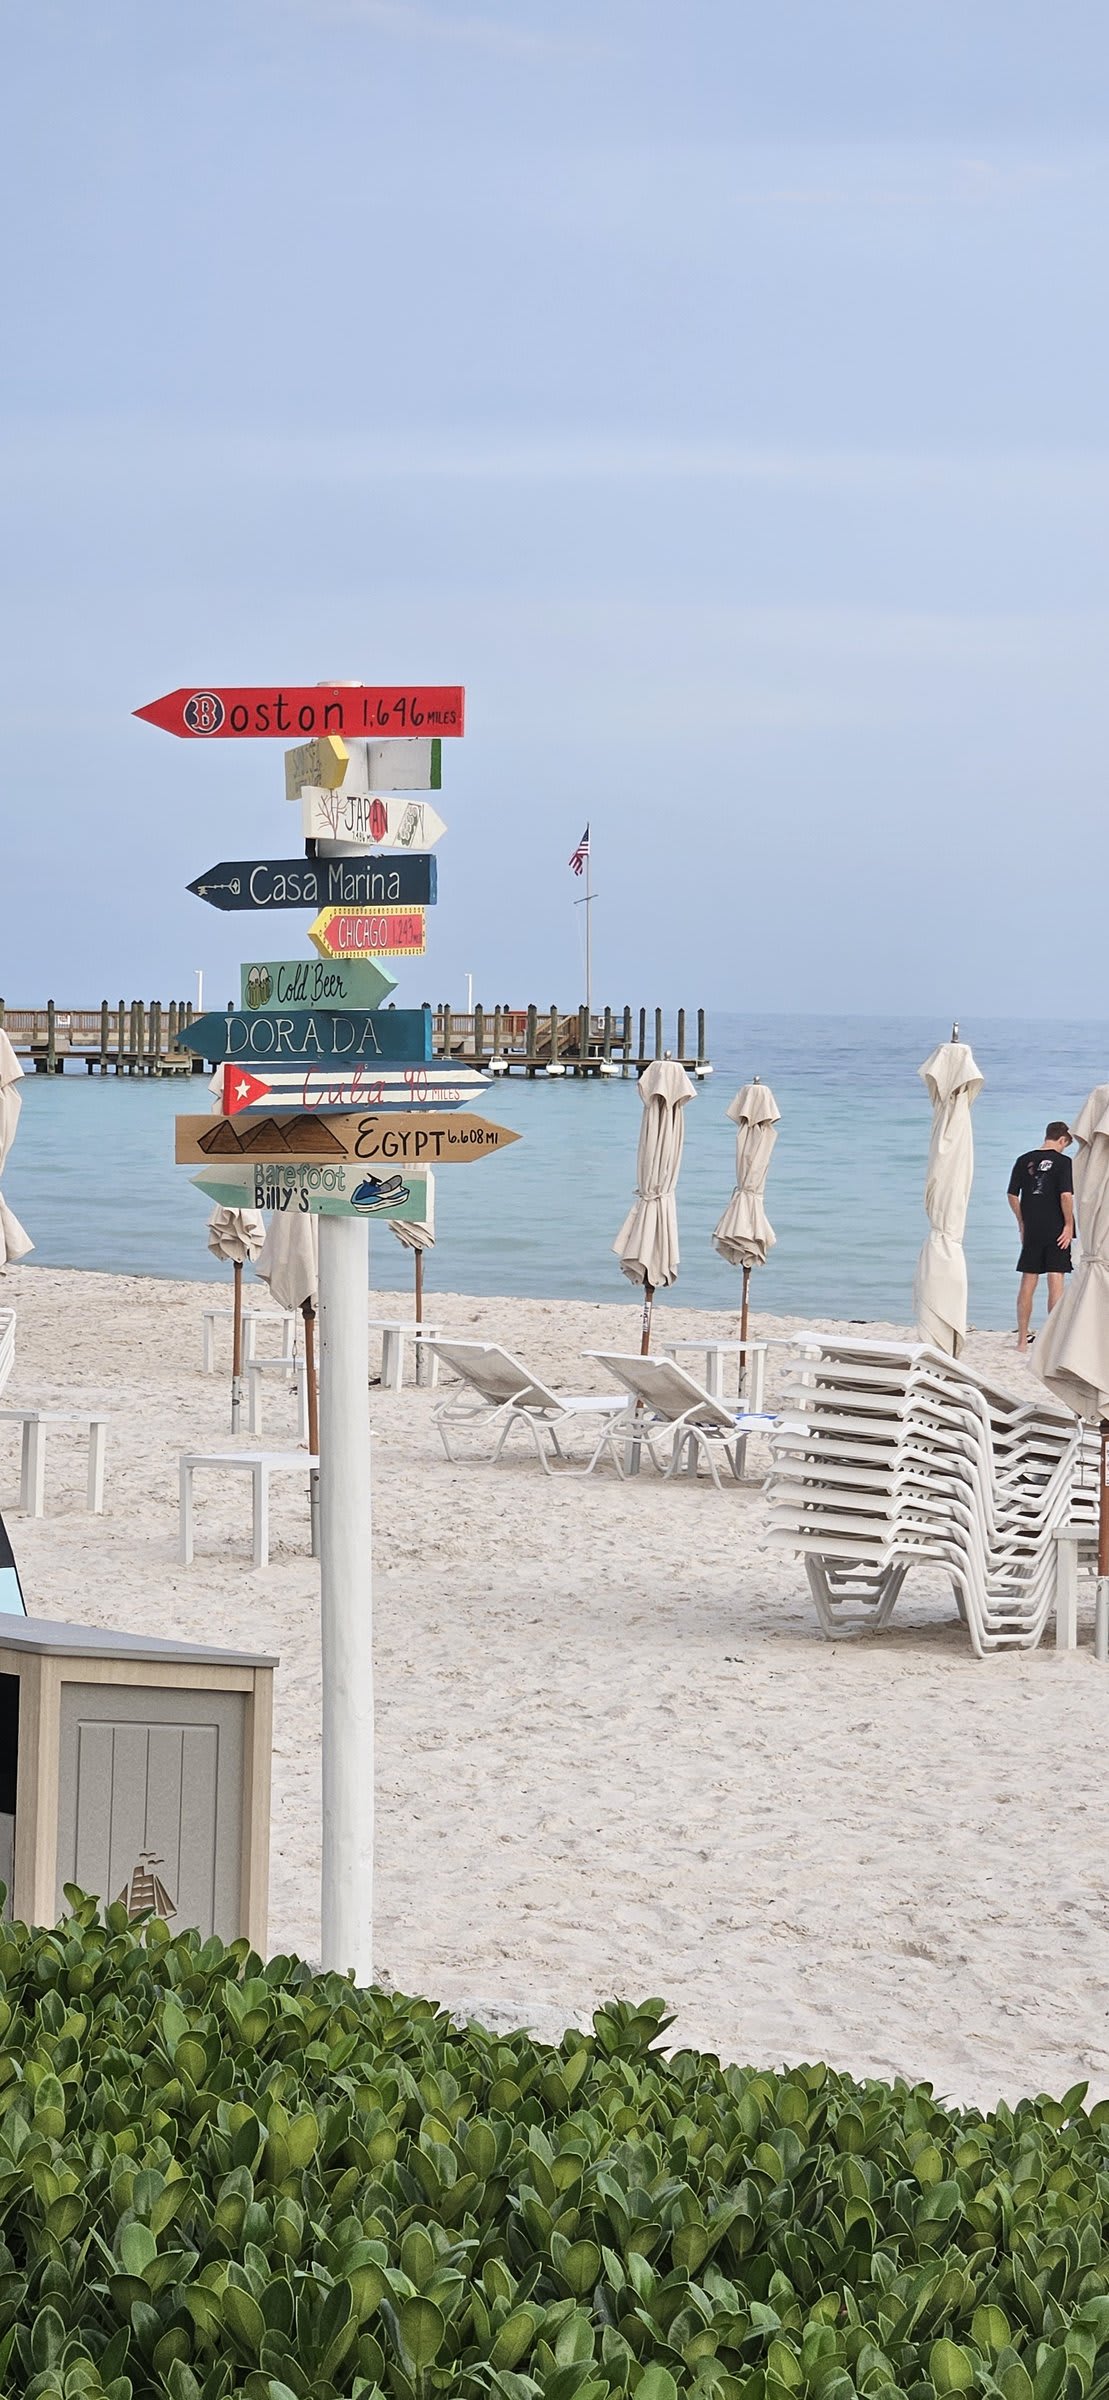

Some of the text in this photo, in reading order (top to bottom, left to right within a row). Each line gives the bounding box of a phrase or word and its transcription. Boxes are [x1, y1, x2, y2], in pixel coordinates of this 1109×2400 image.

[426, 711, 457, 724] MILES
[345, 796, 388, 834] JAPAN
[250, 863, 400, 905] Casa Marina
[338, 917, 388, 949] CHICAGO
[277, 963, 347, 1003] Cold Beer
[224, 1017, 382, 1054] DORADA
[302, 1067, 461, 1111] Cuba 90 MILES
[354, 1117, 446, 1158] EGYPT
[485, 1132, 498, 1145] MI
[254, 1163, 346, 1192] Barefoot
